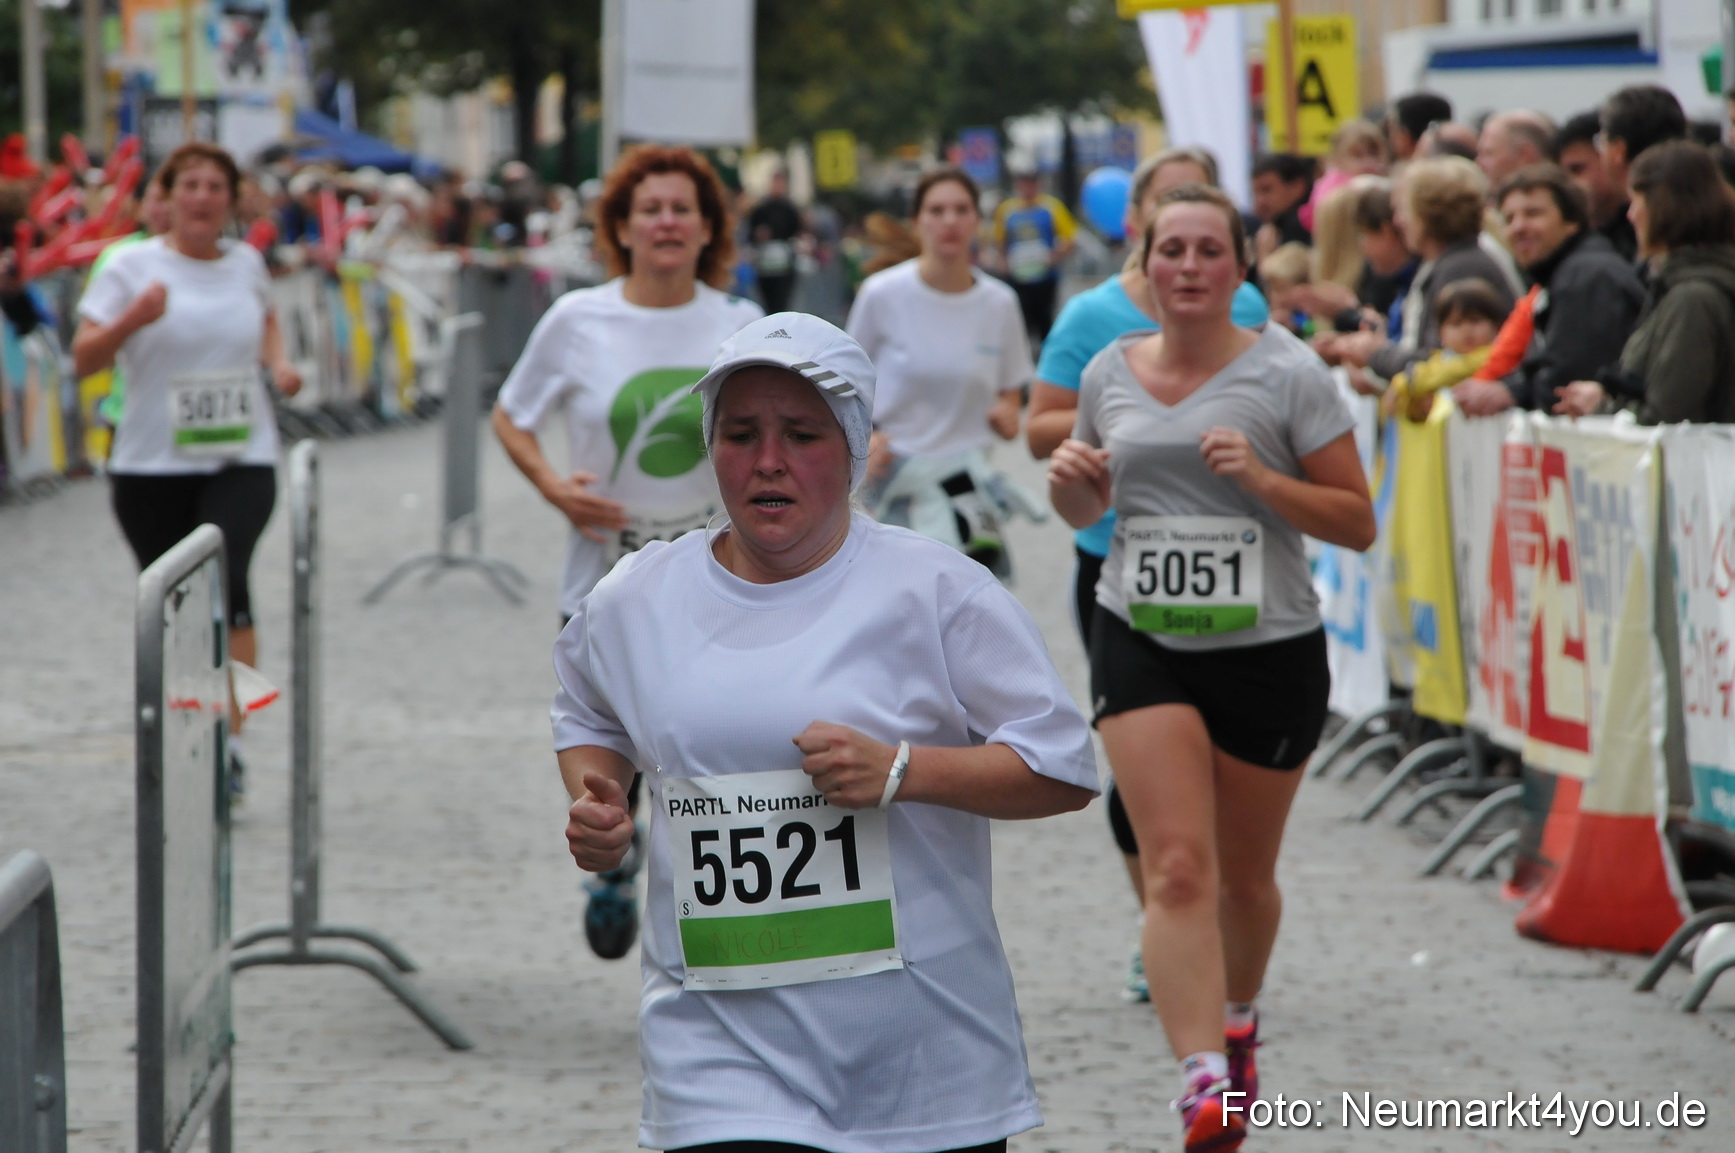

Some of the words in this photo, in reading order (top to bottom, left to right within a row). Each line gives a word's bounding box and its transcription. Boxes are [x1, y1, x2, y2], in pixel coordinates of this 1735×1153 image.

[1296, 59, 1336, 119] A
[1170, 530, 1236, 542] Neumarkt
[1136, 550, 1241, 597] 5051
[1162, 609, 1213, 635] Sonja
[669, 797, 731, 817] PARTL
[737, 794, 828, 813] Neumar
[691, 815, 861, 906] 5521
[712, 926, 808, 960] NICOLE
